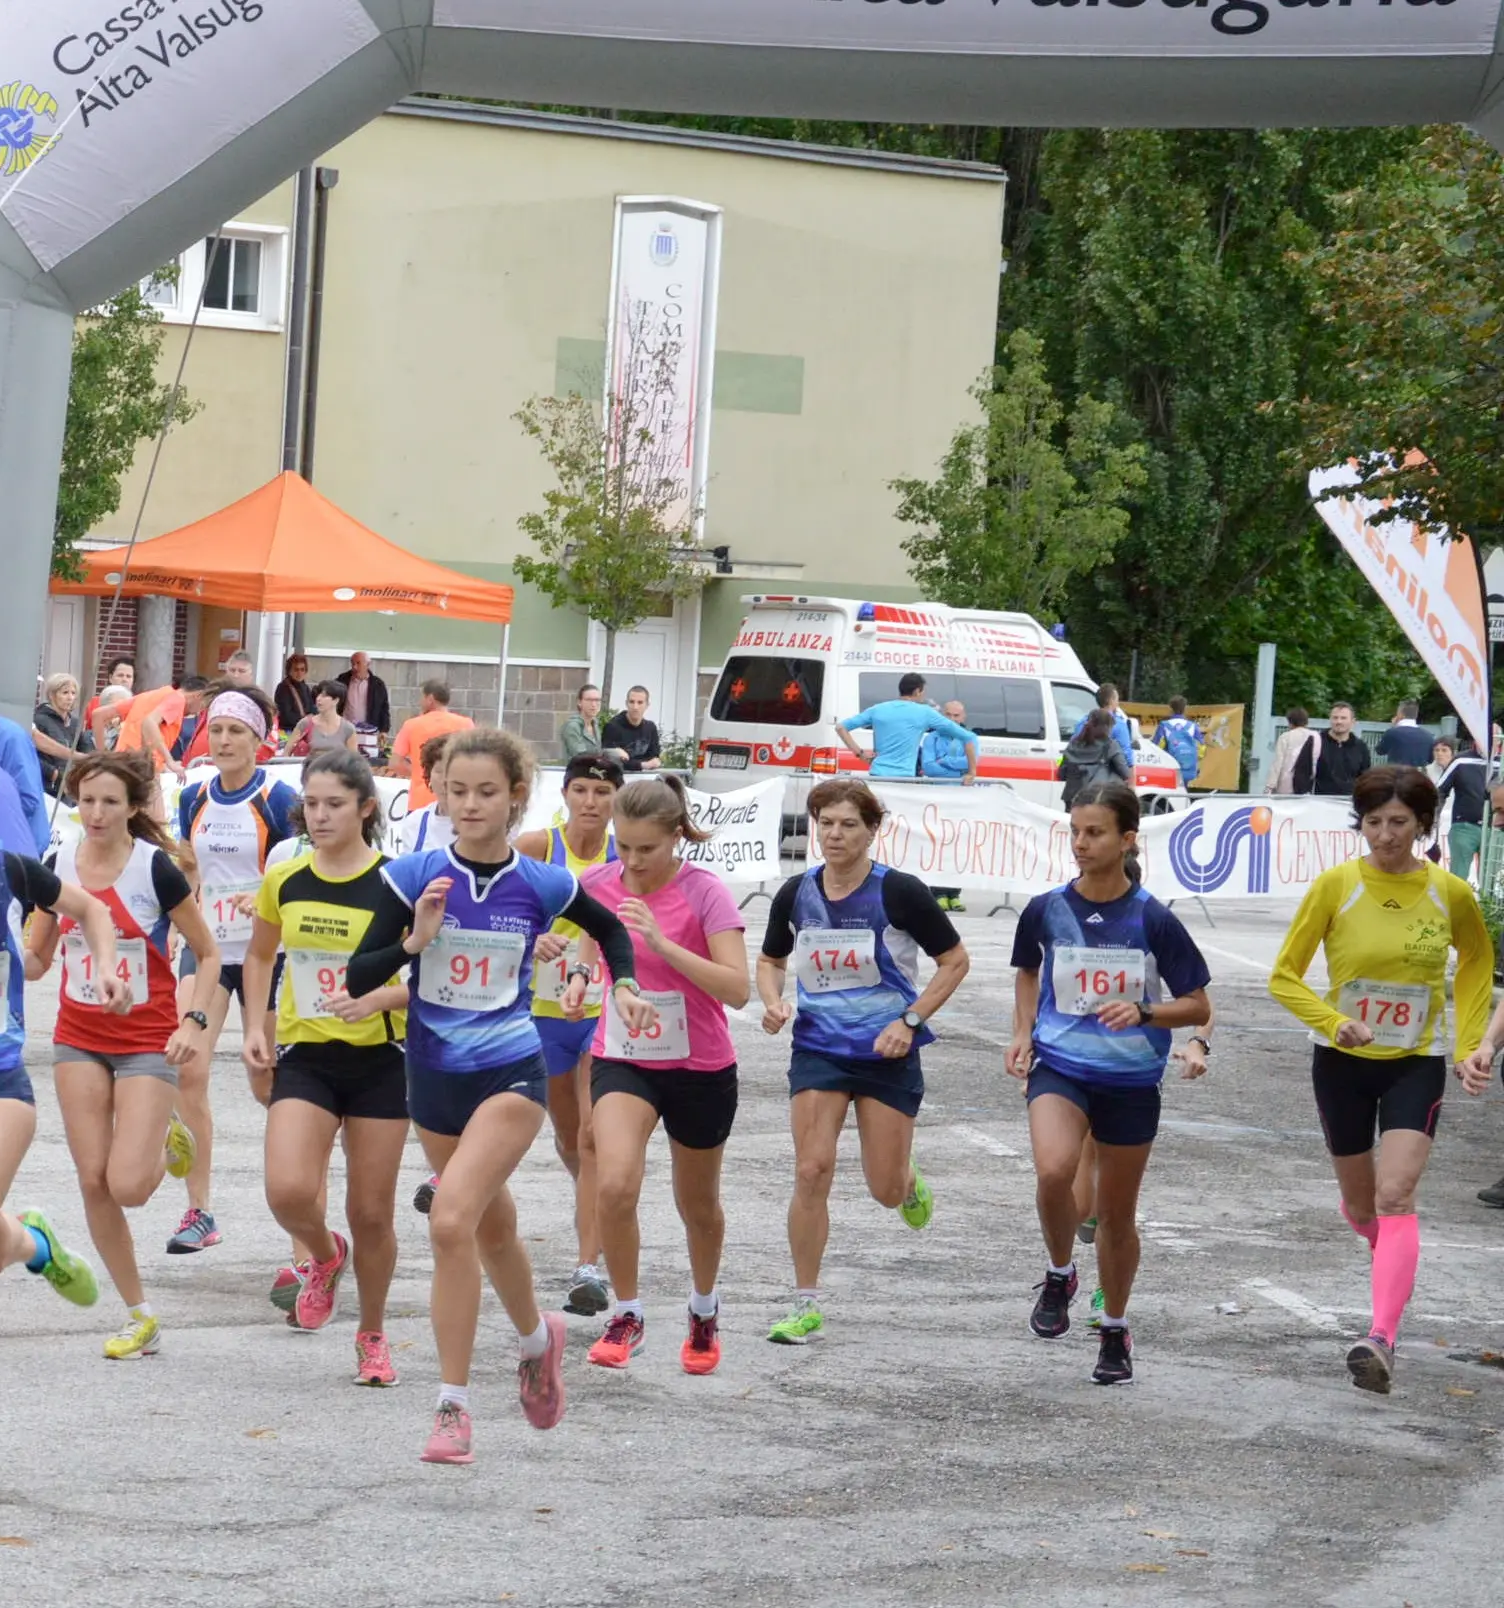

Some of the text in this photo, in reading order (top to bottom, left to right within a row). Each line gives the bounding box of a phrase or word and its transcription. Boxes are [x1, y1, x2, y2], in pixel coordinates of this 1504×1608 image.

[53, 0, 165, 75] Cassa
[75, 0, 263, 128] Alta Valsug
[732, 631, 833, 652] AMBULANZA
[874, 652, 920, 666] CROCE
[927, 655, 970, 669] ROSSA
[976, 658, 1036, 674] ITALIANA
[703, 796, 759, 825] Rurale
[920, 803, 1038, 881] SPORTIVO
[212, 898, 250, 922] 17
[81, 953, 132, 983] 14
[449, 954, 491, 988] 91
[554, 958, 605, 985] 10
[809, 949, 861, 972] 174
[1074, 968, 1127, 996] 161
[1355, 996, 1412, 1028] 178
